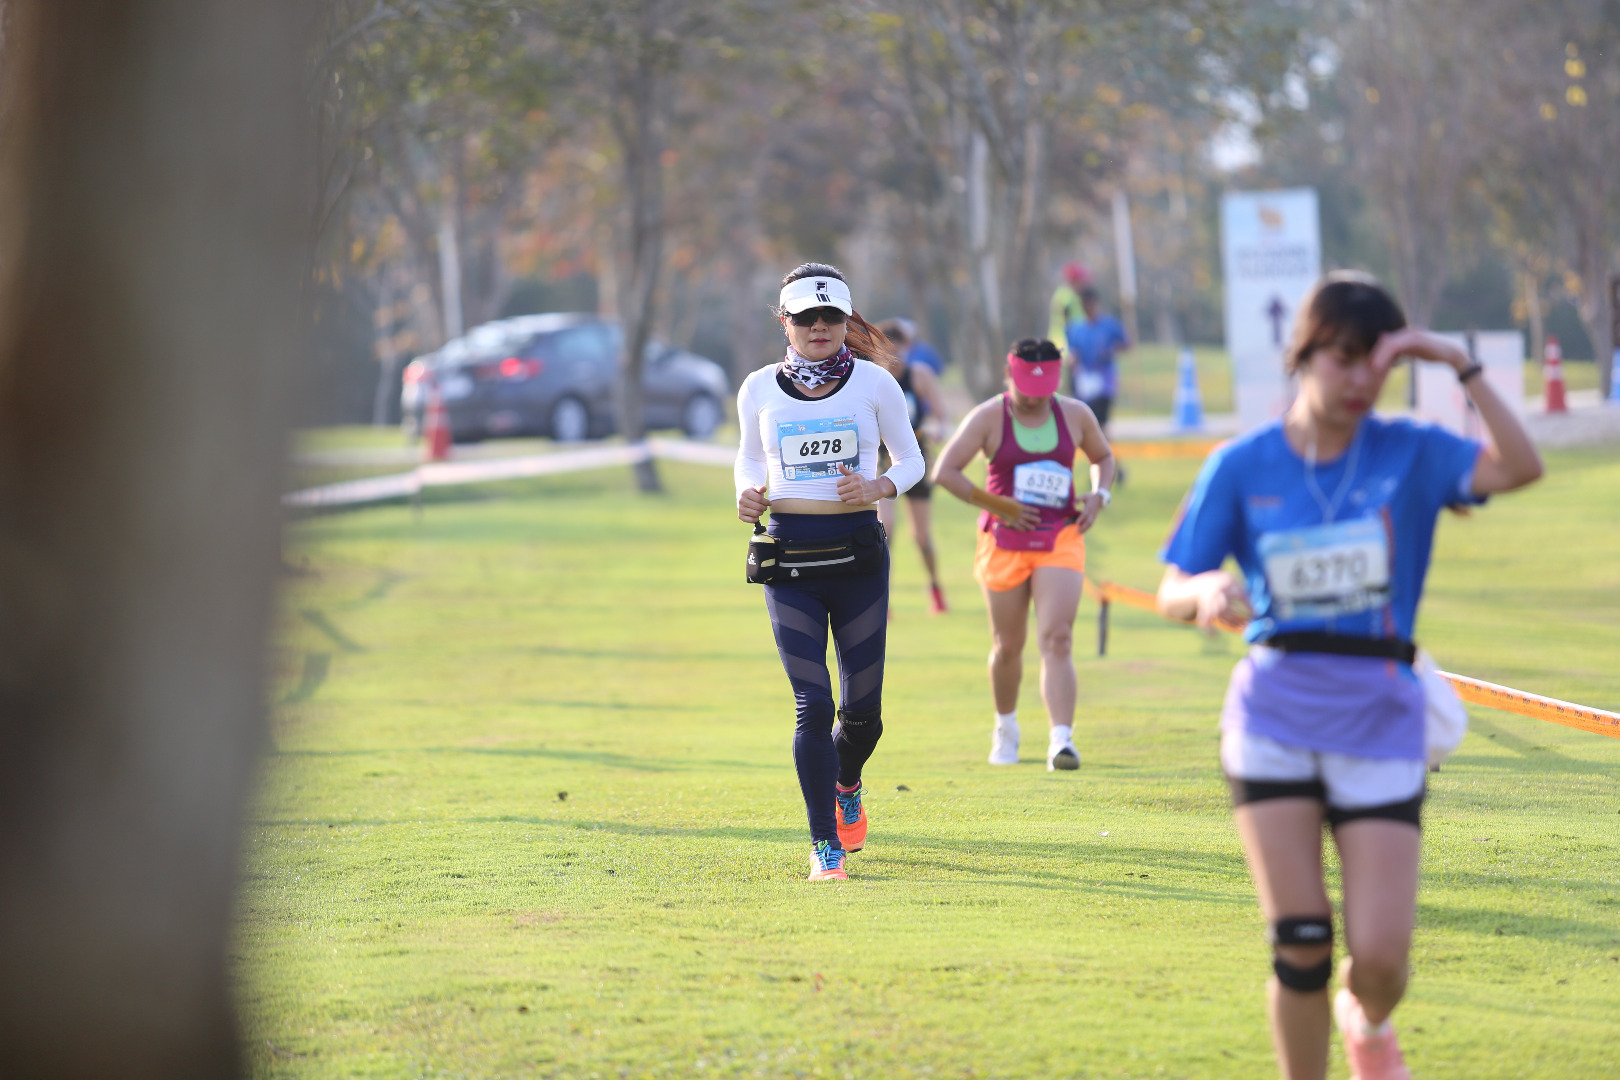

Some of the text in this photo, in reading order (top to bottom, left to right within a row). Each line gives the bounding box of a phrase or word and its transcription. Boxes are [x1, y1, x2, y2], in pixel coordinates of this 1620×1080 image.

[799, 438, 842, 457] 6278
[1026, 473, 1063, 491] 6352
[1289, 549, 1368, 589] 6370
